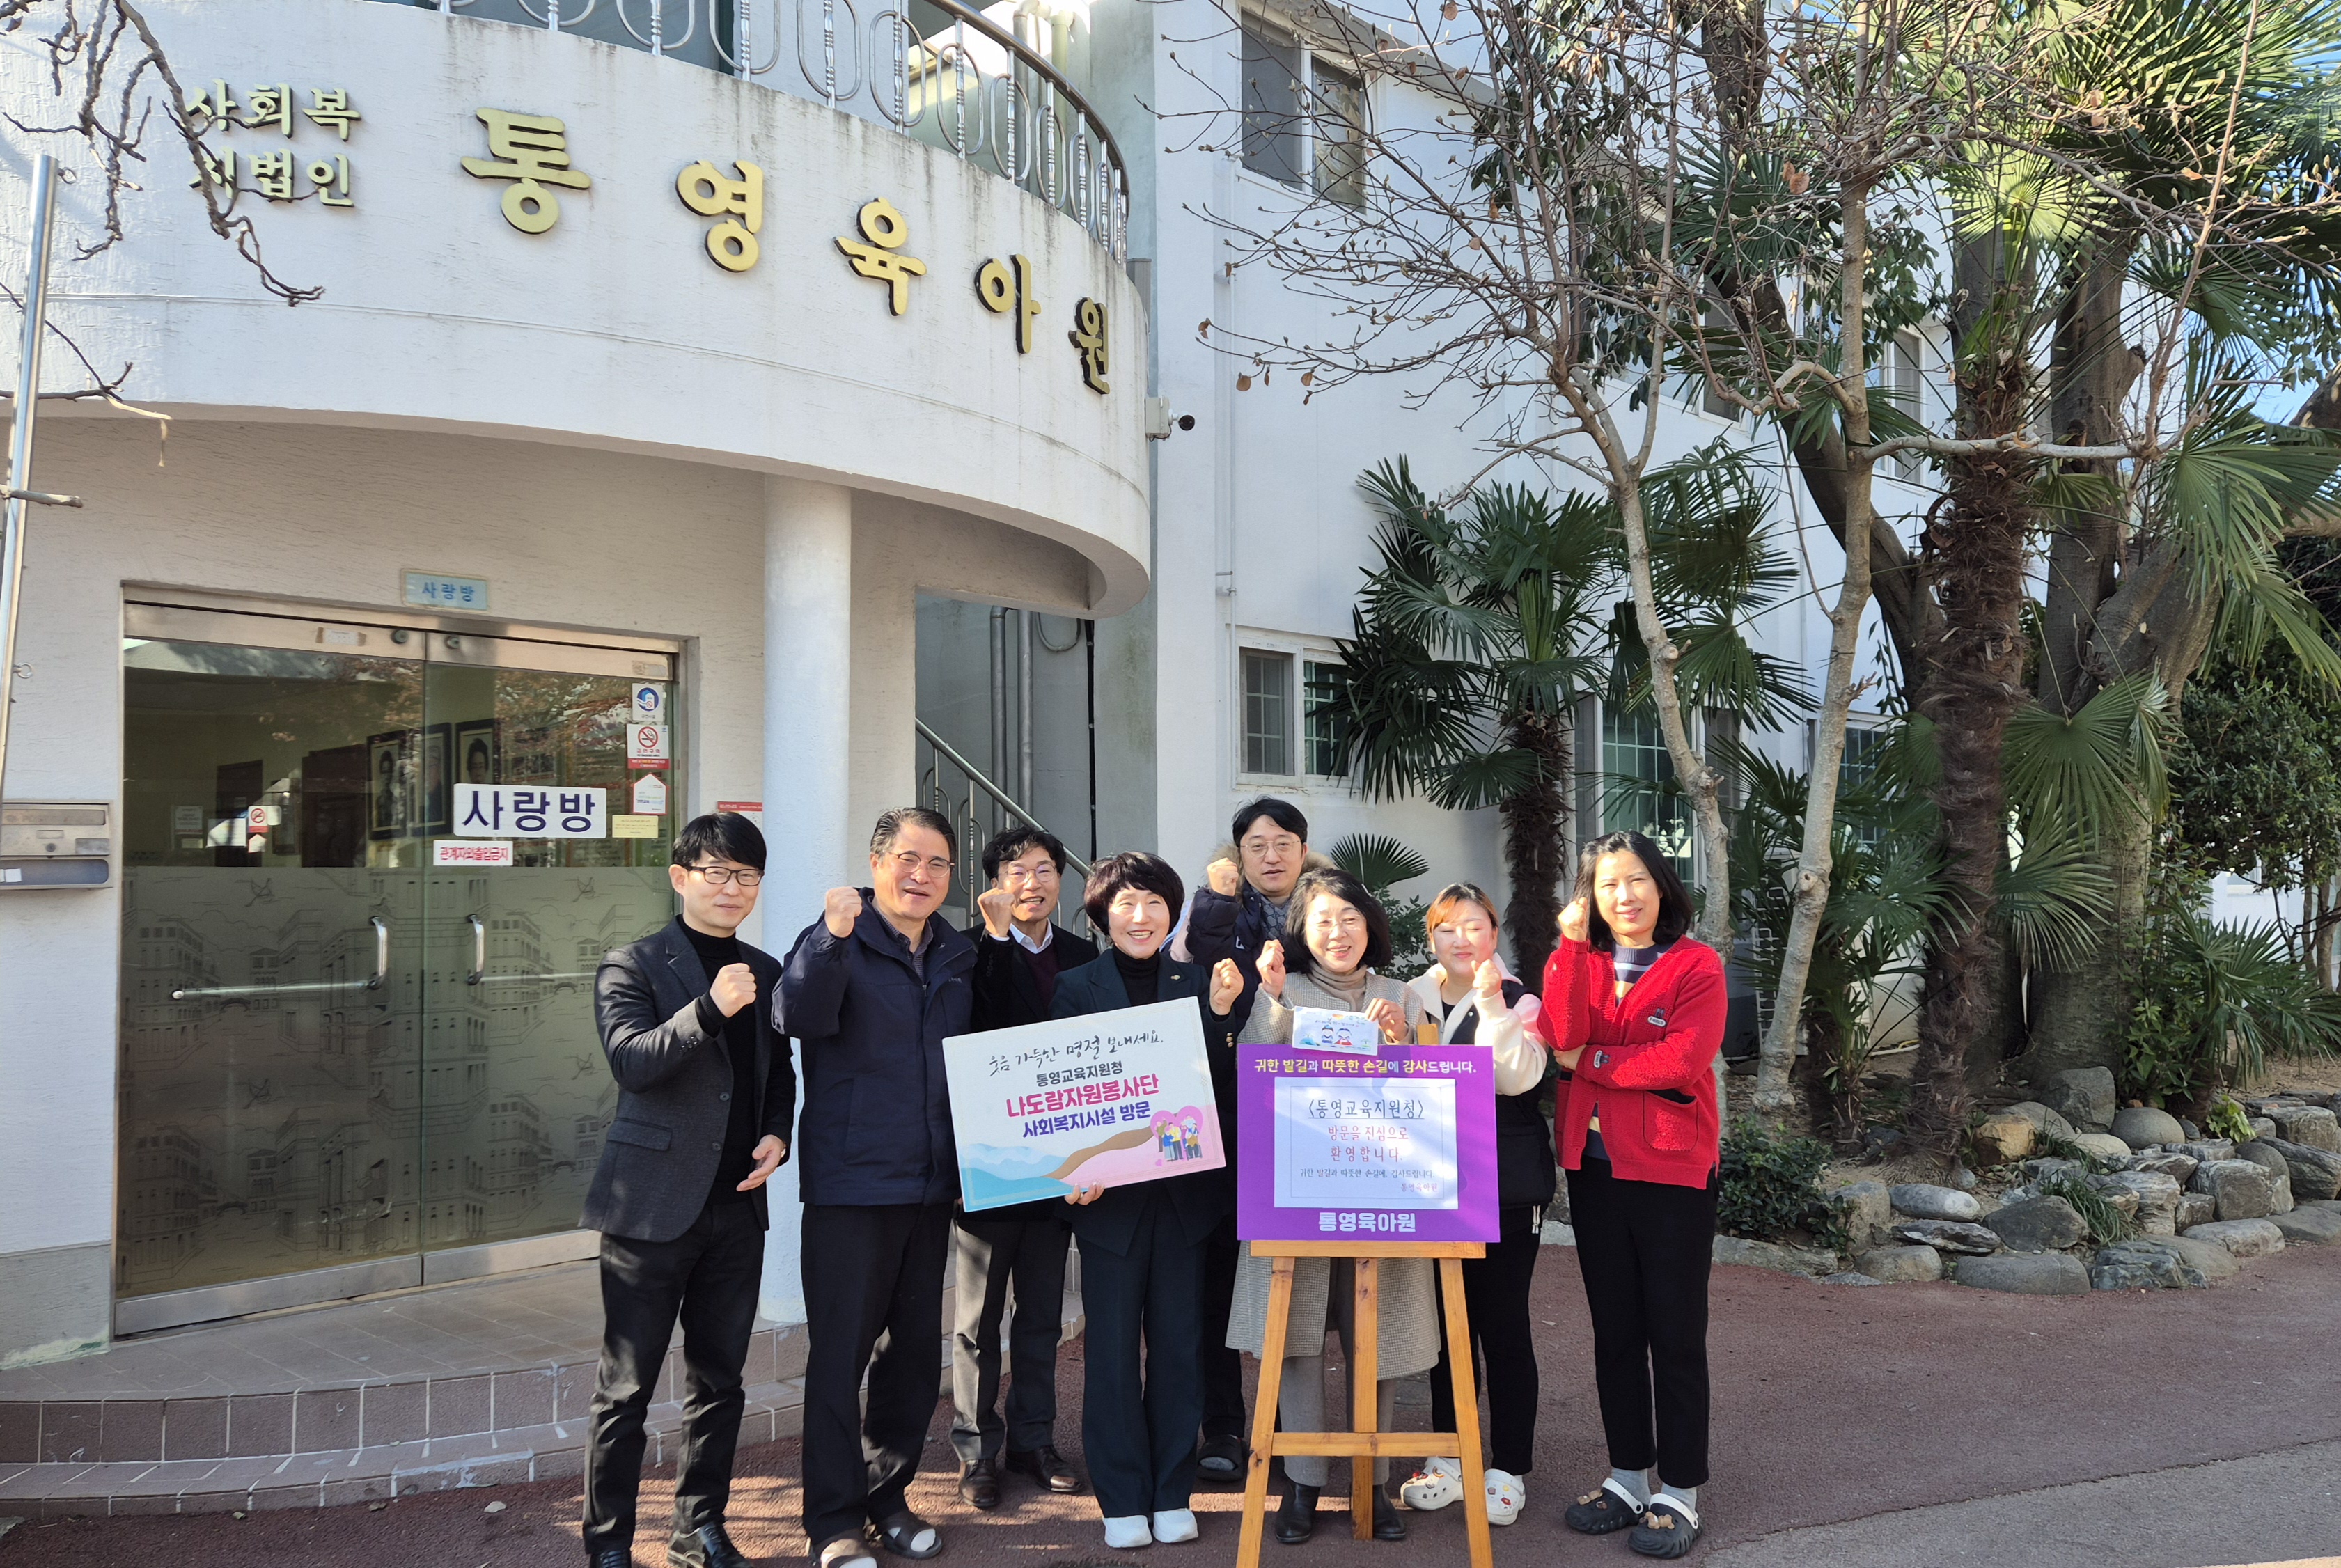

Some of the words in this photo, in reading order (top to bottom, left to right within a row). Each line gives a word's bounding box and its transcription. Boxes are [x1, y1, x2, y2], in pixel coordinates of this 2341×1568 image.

[185, 78, 361, 142] 사회복
[460, 107, 1110, 395] 통영육아원
[421, 581, 476, 602] 사랑방
[462, 790, 595, 833] 사랑방
[439, 846, 509, 861] 관계자외출입금지
[989, 1055, 1011, 1076] 웃음
[1015, 1046, 1060, 1069] 가득한
[1066, 1035, 1100, 1060] 명절
[1107, 1030, 1164, 1053] 보내세요.
[1035, 1060, 1124, 1088] 통영교육지원청
[1254, 1058, 1279, 1073] 귀한
[1283, 1059, 1319, 1073] 발길과
[1322, 1059, 1359, 1073] 따뜻한
[1363, 1059, 1400, 1074] 손길에
[1402, 1059, 1477, 1074] 감사드립니다.
[1006, 1073, 1159, 1118] 나도람자원봉사단
[1022, 1106, 1117, 1138] 사회복지시설
[1119, 1101, 1152, 1122] 방문
[1328, 1125, 1361, 1141] 방문을
[1365, 1125, 1409, 1142] 진심으로
[1331, 1145, 1403, 1162] 환영합니다.
[1299, 1168, 1314, 1178] 귀한
[1317, 1168, 1338, 1178] 발길과
[1340, 1168, 1362, 1178] 따뜻한
[1400, 1182, 1438, 1193] 통영육아원
[1318, 1212, 1416, 1233] 통영육아원
